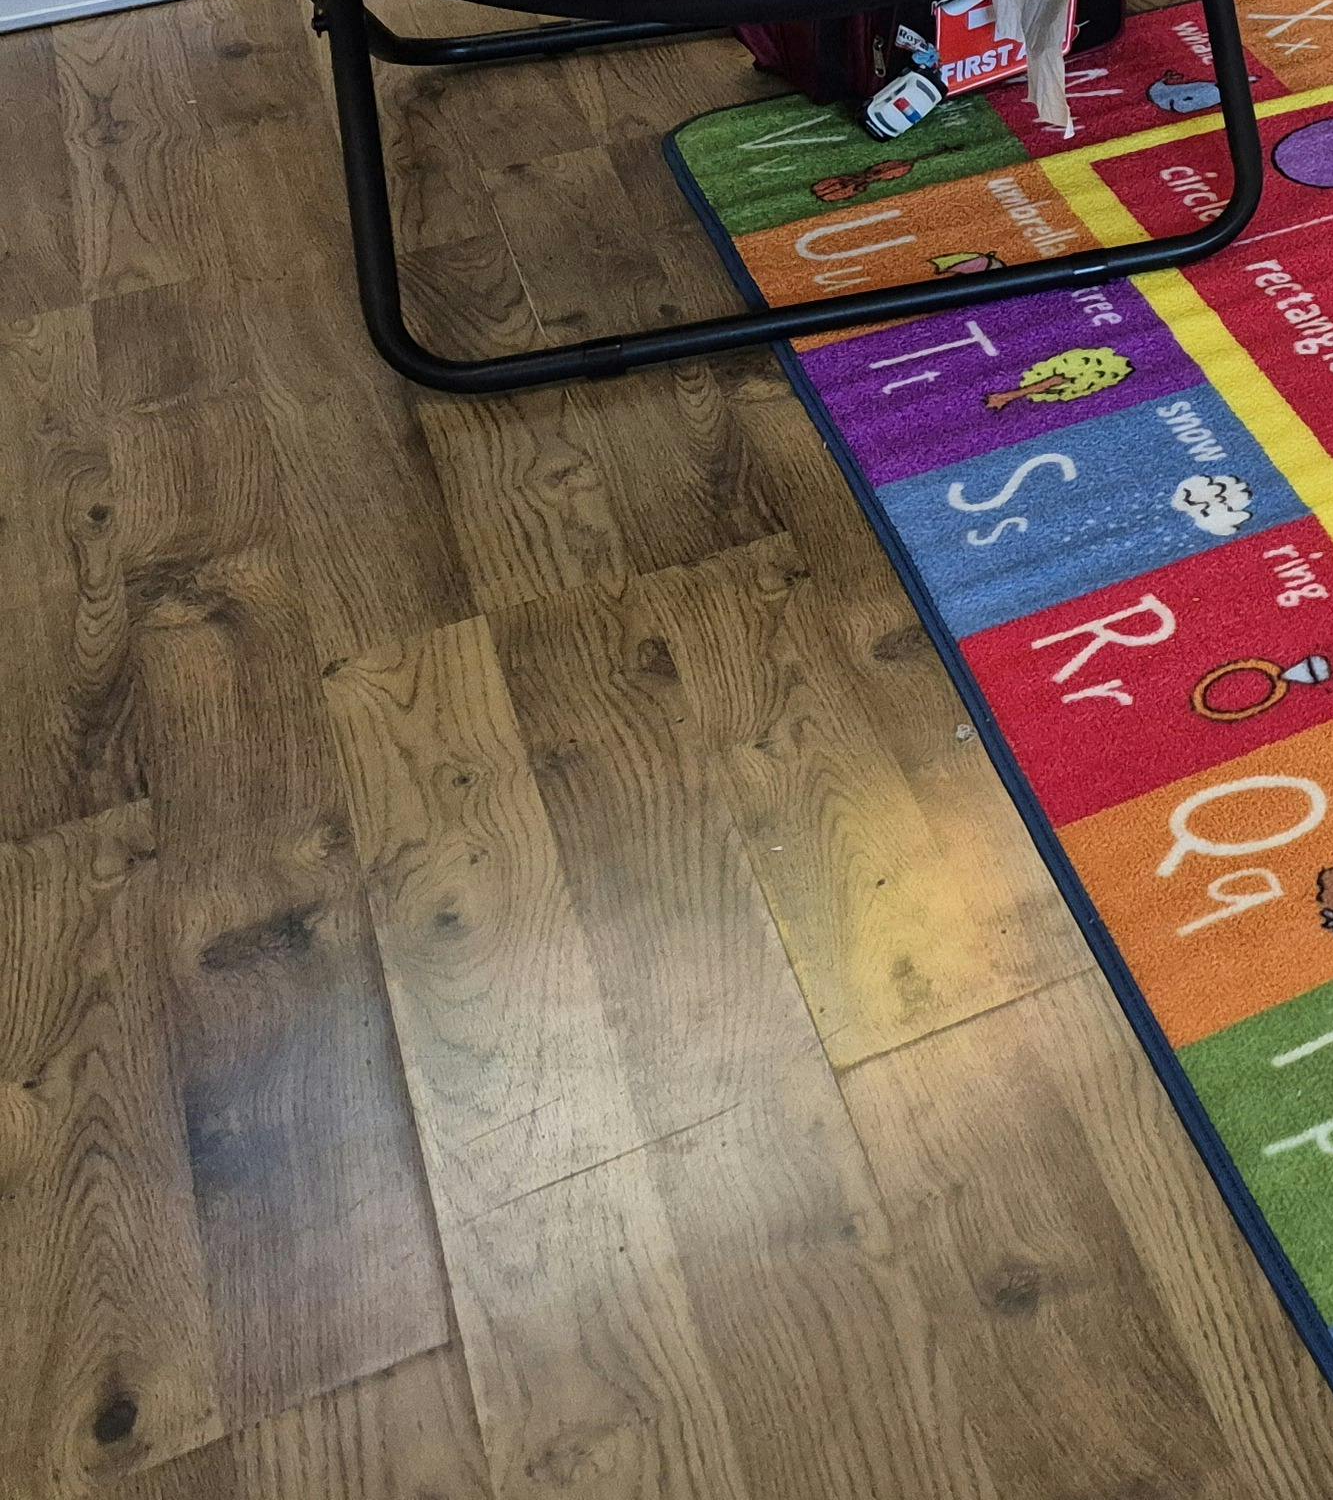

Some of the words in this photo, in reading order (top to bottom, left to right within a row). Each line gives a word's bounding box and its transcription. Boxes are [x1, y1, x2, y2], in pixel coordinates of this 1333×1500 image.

[941, 43, 1013, 84] FIRST
[1158, 398, 1227, 465] snow
[1263, 542, 1330, 609] ring
